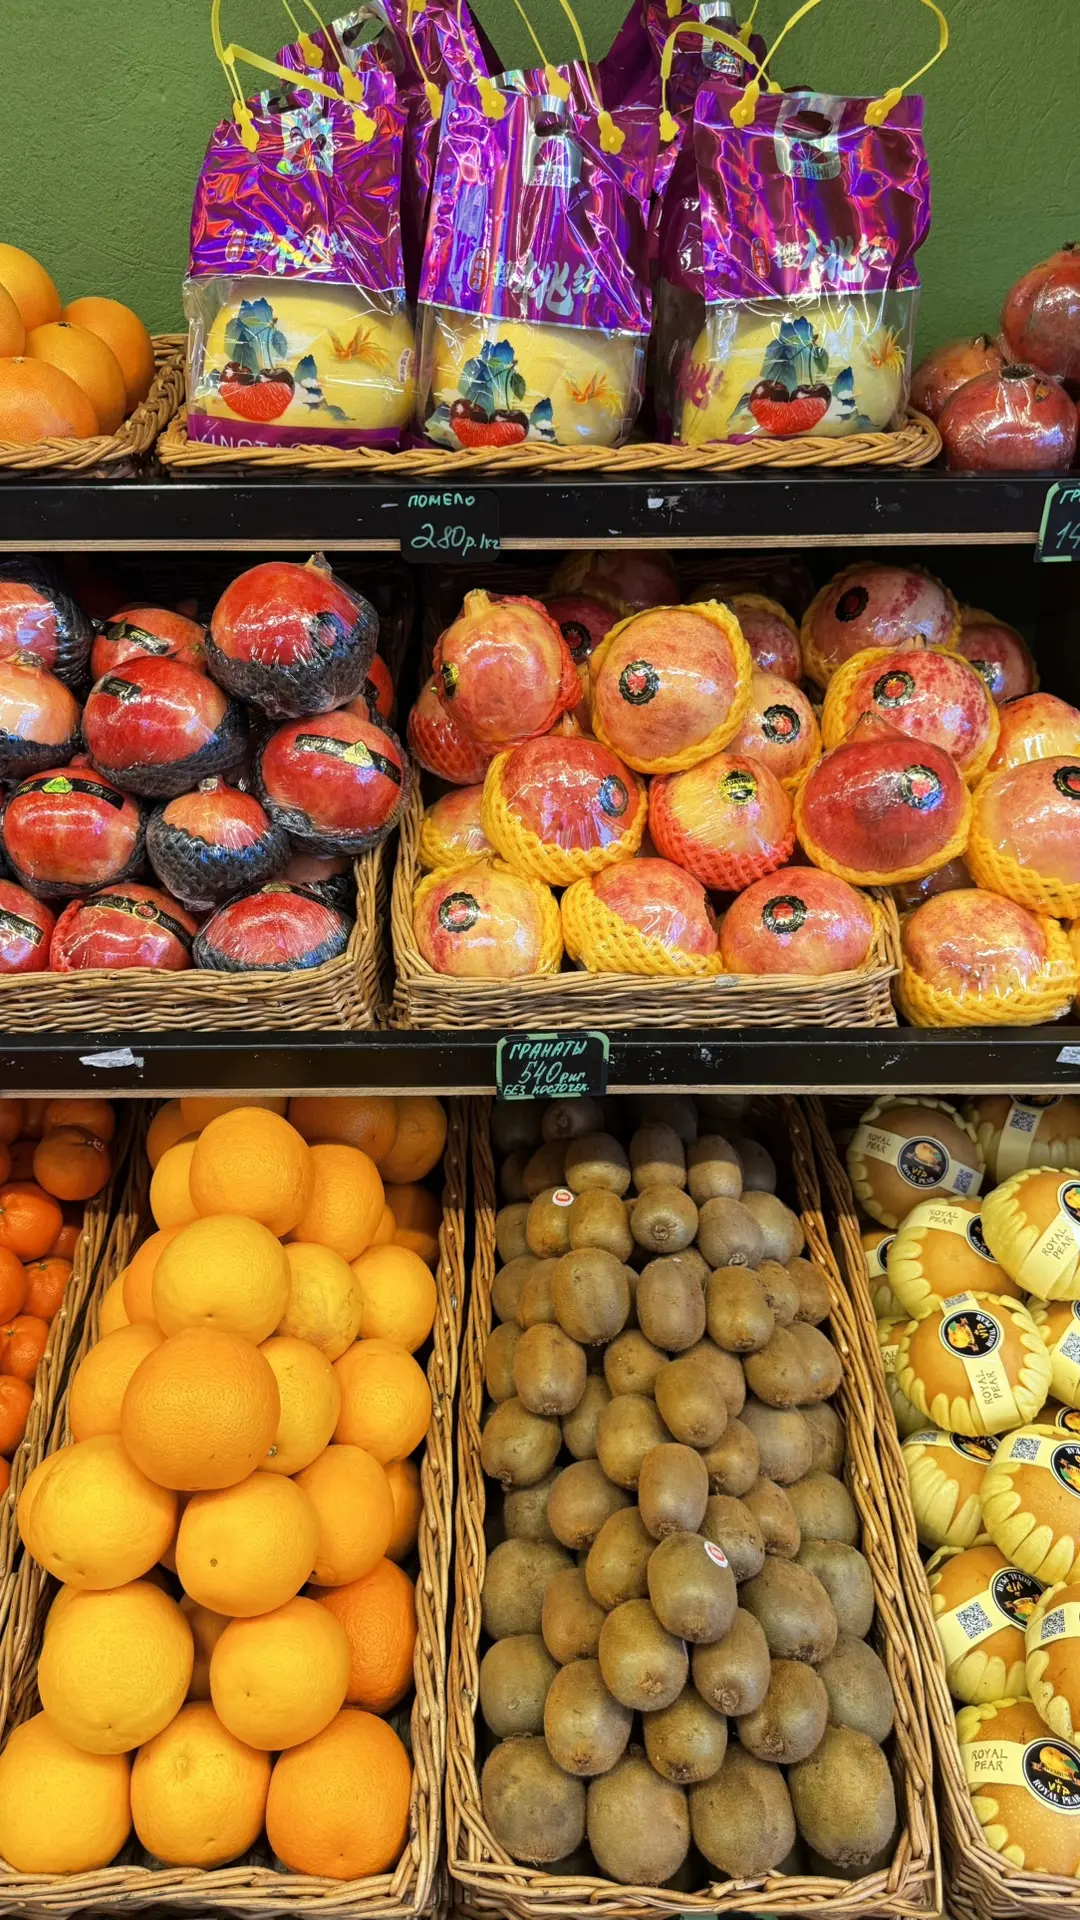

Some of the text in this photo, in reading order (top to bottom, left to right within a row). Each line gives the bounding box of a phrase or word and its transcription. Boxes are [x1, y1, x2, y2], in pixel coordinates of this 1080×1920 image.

[408, 493, 475, 507] ПОМЕЛО
[1059, 488, 1080, 504] ГР
[509, 1041, 587, 1060] ГРАНАТЫ
[503, 1084, 527, 1096] БЕЗ
[867, 1133, 891, 1146] ROYAL
[866, 1141, 886, 1154] PEAR
[929, 1209, 958, 1219] ROYAL
[929, 1216, 953, 1226] PEAR
[1042, 1228, 1067, 1256] ROYAL
[1053, 1236, 1075, 1260] PEAR
[977, 1323, 989, 1339] VIP
[976, 1369, 994, 1405] ROYAL
[986, 1371, 1003, 1399] PEAR
[996, 1573, 1032, 1592] ROYAL PEAR
[1006, 1581, 1023, 1593] VIP
[971, 1748, 1008, 1760] ROYAL
[974, 1760, 1004, 1772] PEAR
[1033, 1779, 1059, 1802] ROYAL
[1048, 1781, 1070, 1796] VIP
